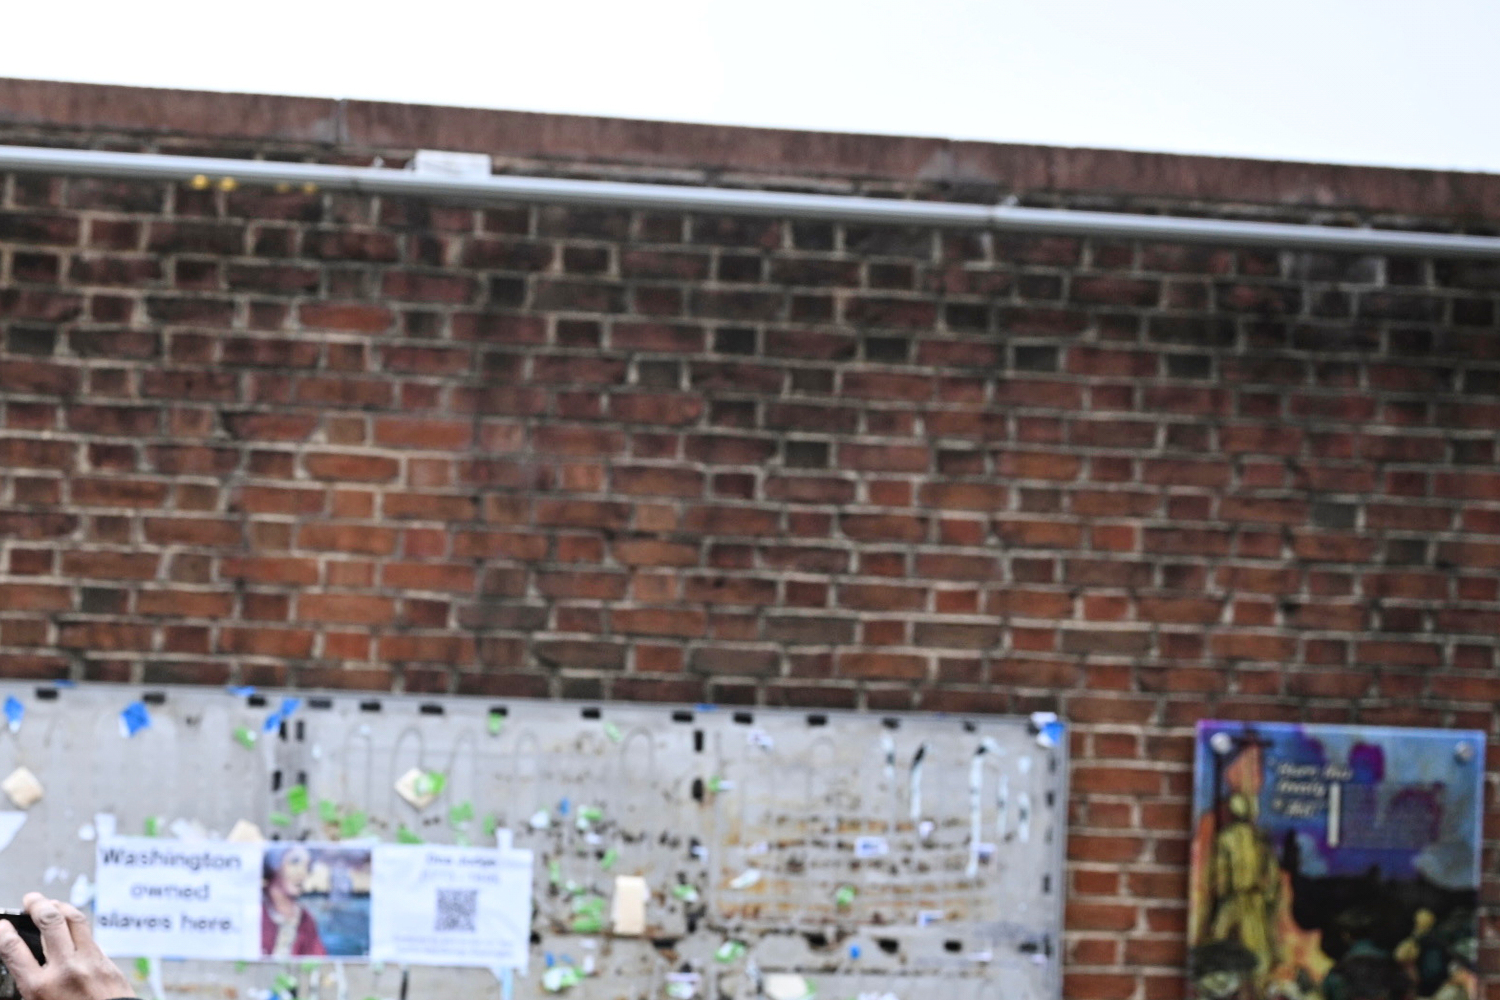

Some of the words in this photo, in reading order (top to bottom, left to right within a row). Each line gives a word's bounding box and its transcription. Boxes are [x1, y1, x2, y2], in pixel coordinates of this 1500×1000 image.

[102, 848, 241, 871] Washington
[130, 883, 211, 900] owned
[98, 911, 172, 930] slaves
